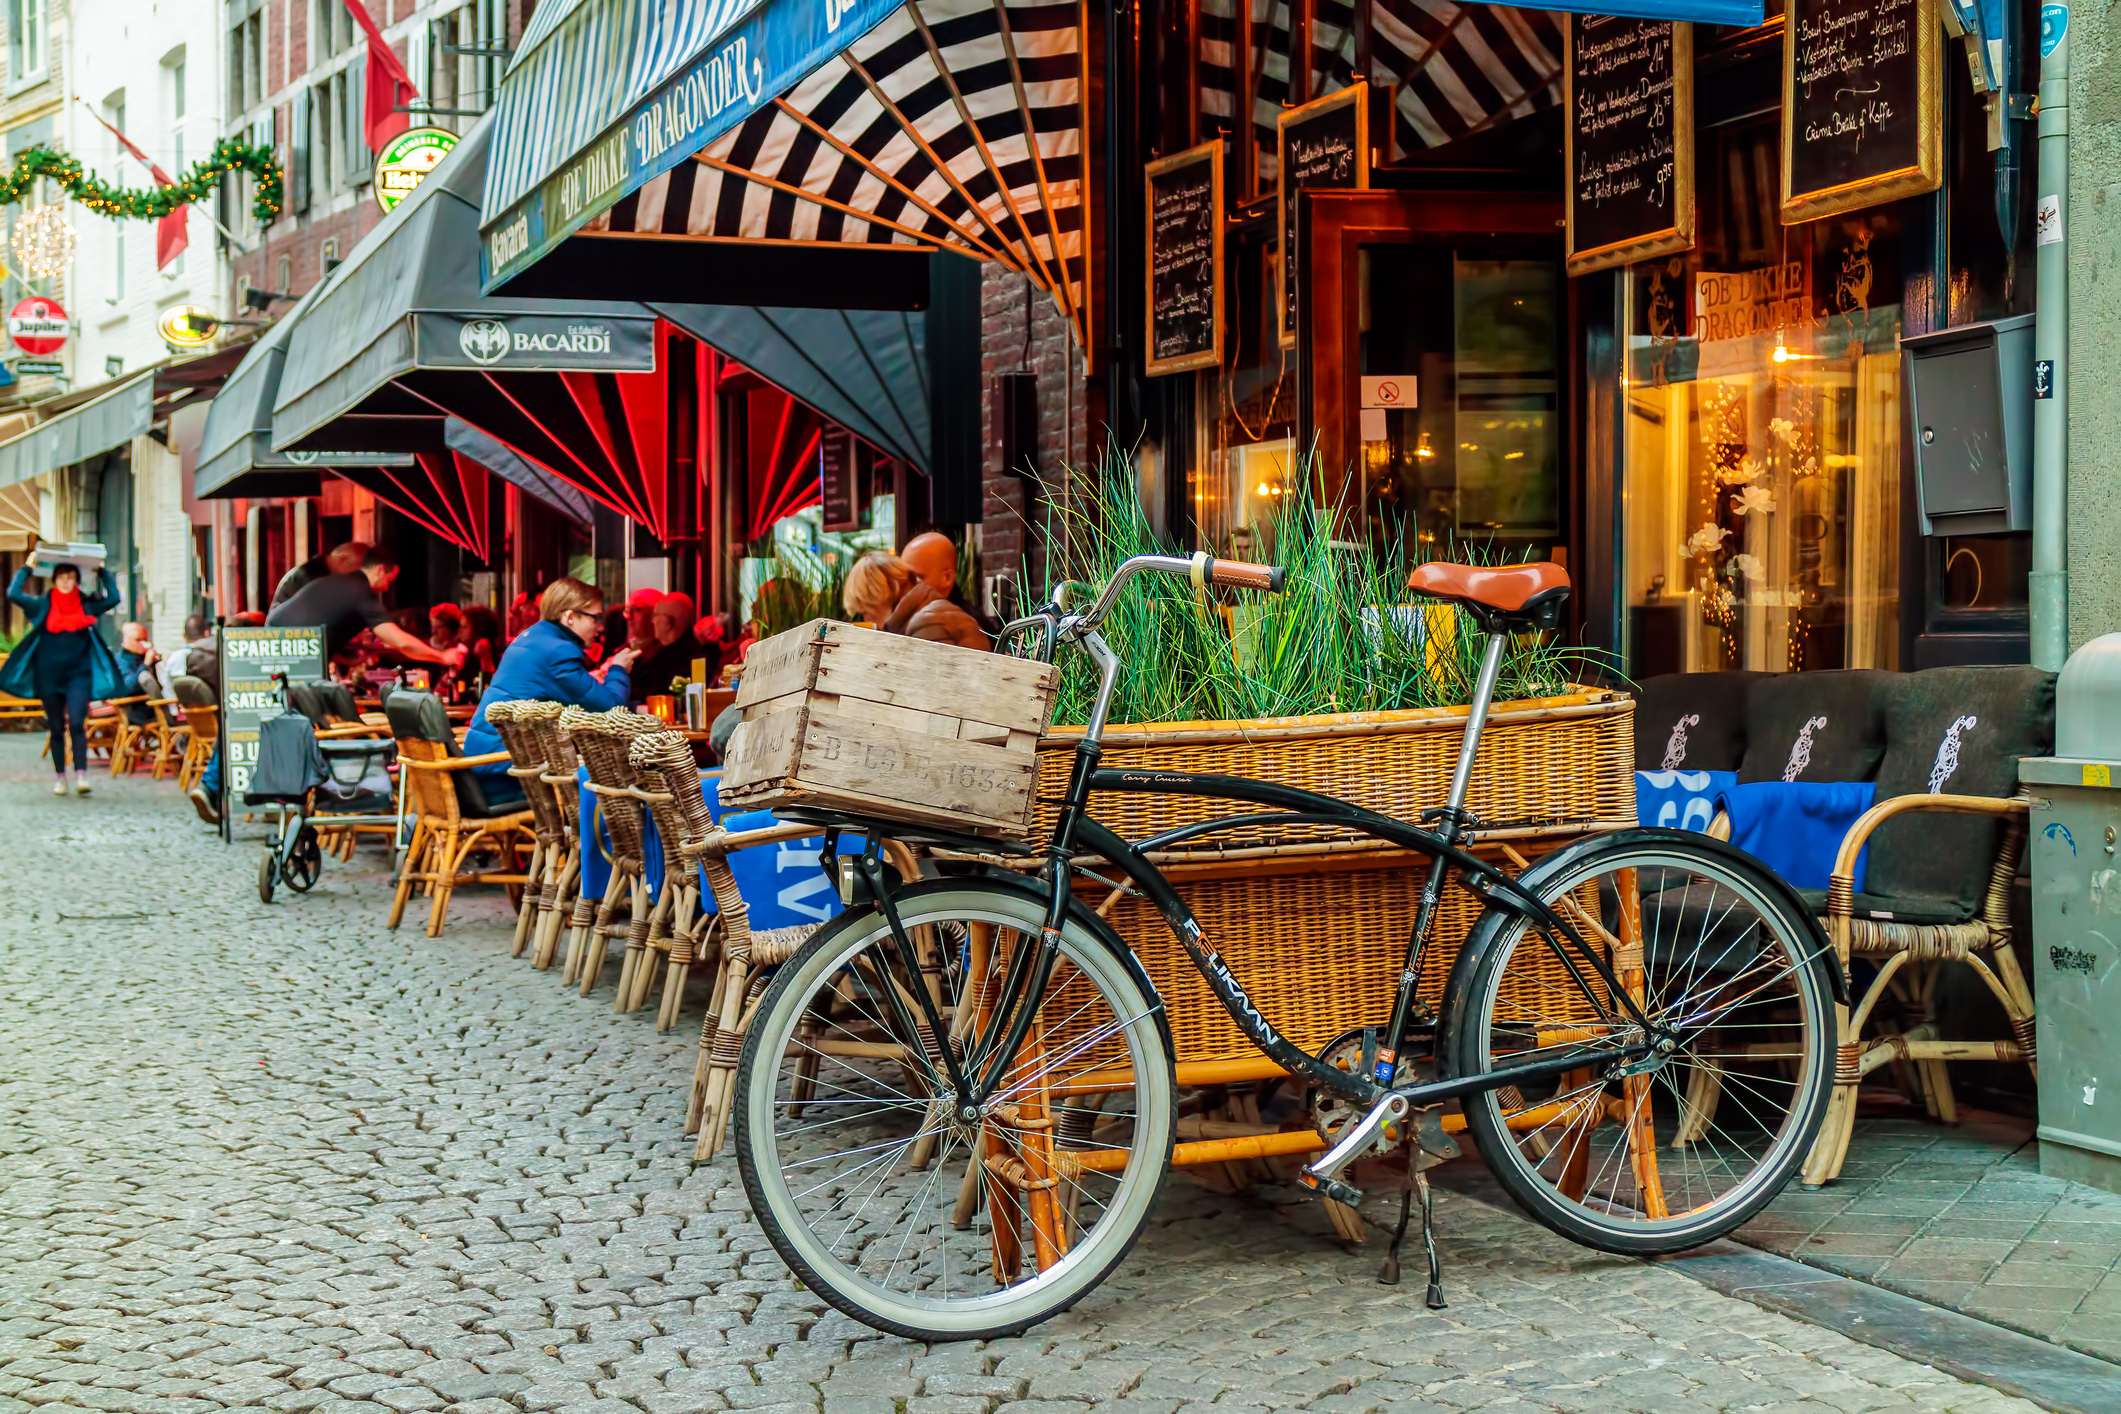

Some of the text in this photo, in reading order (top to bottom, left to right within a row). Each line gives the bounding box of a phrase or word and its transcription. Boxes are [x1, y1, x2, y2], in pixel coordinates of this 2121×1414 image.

[561, 36, 762, 221] DE DIKKE DRAGONDER
[491, 213, 529, 277] Bavaria
[1701, 261, 1803, 308] DE DIKKE
[16, 321, 63, 333] Jupiler
[1695, 296, 1829, 344] DRAGONDER
[227, 628, 316, 640] MONDAY DEAL
[229, 681, 278, 692] TUESDA
[1123, 773, 1151, 783] Carry
